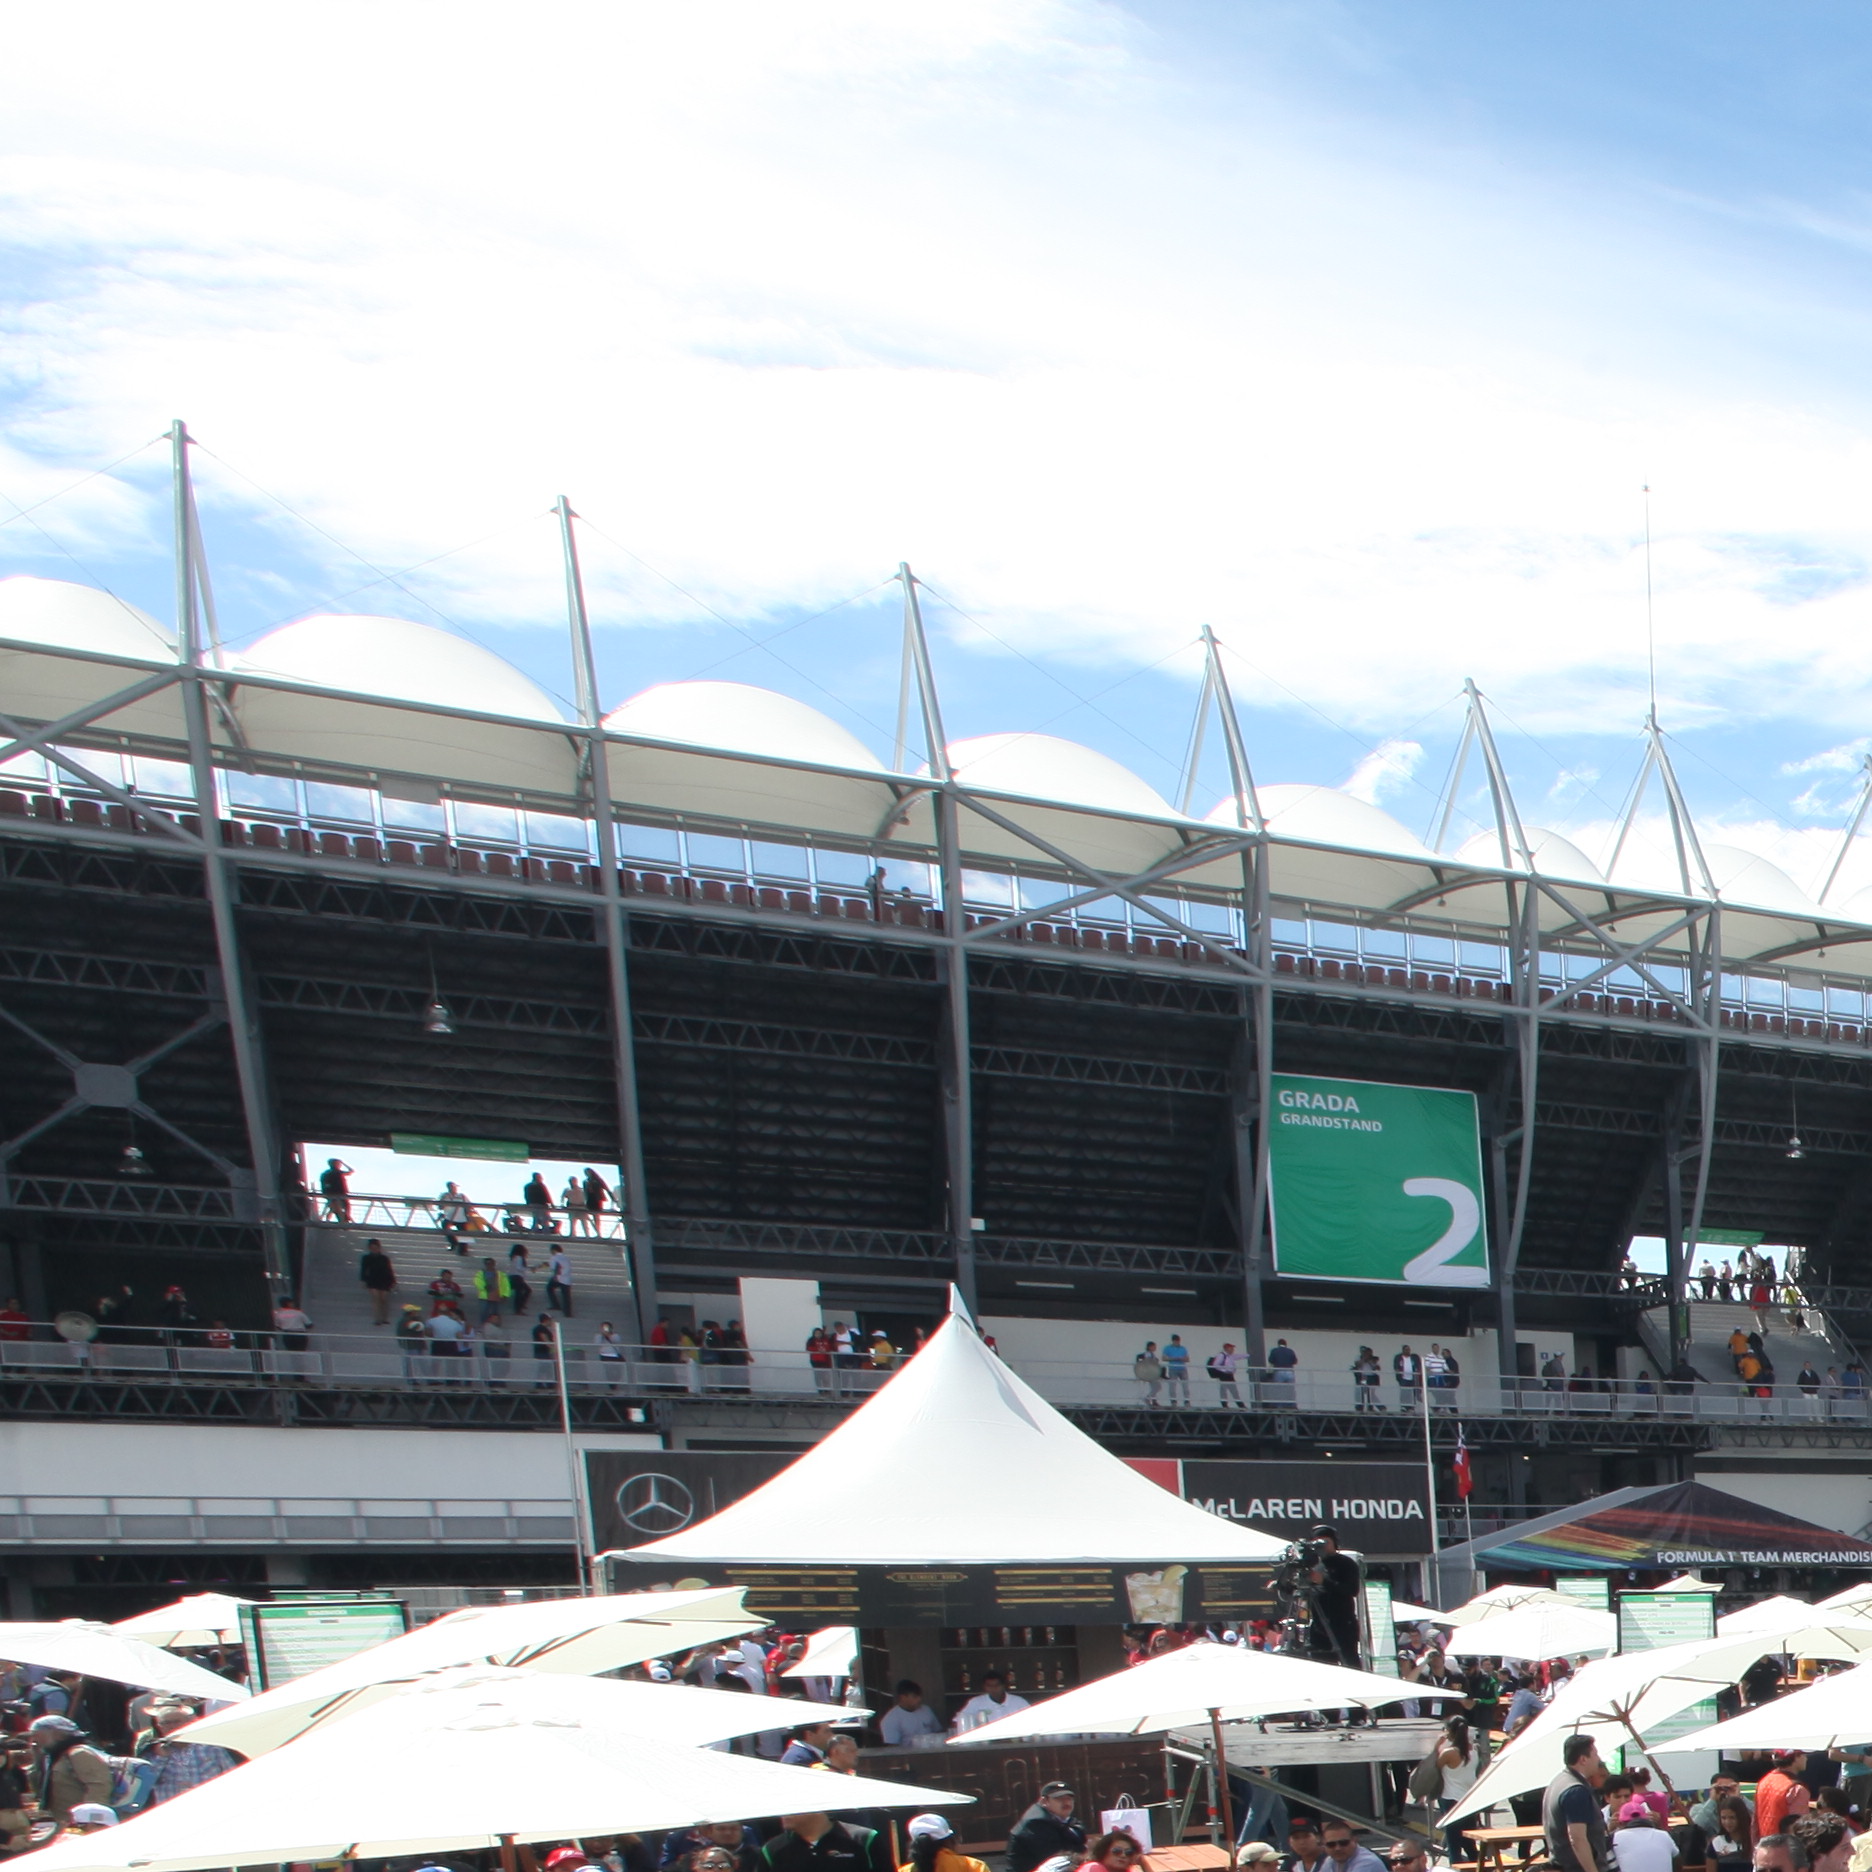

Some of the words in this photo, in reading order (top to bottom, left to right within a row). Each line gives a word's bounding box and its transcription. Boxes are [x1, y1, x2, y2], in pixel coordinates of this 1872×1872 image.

[1279, 1090, 1360, 1113] GRADA
[1280, 1112, 1382, 1132] GRANDSTAND
[1403, 1177, 1488, 1284] 2
[1193, 1498, 1323, 1519] McLAREN
[1332, 1499, 1425, 1519] HONDA
[1657, 1551, 1725, 1563] FORMULA
[1741, 1551, 1780, 1563] TEAM
